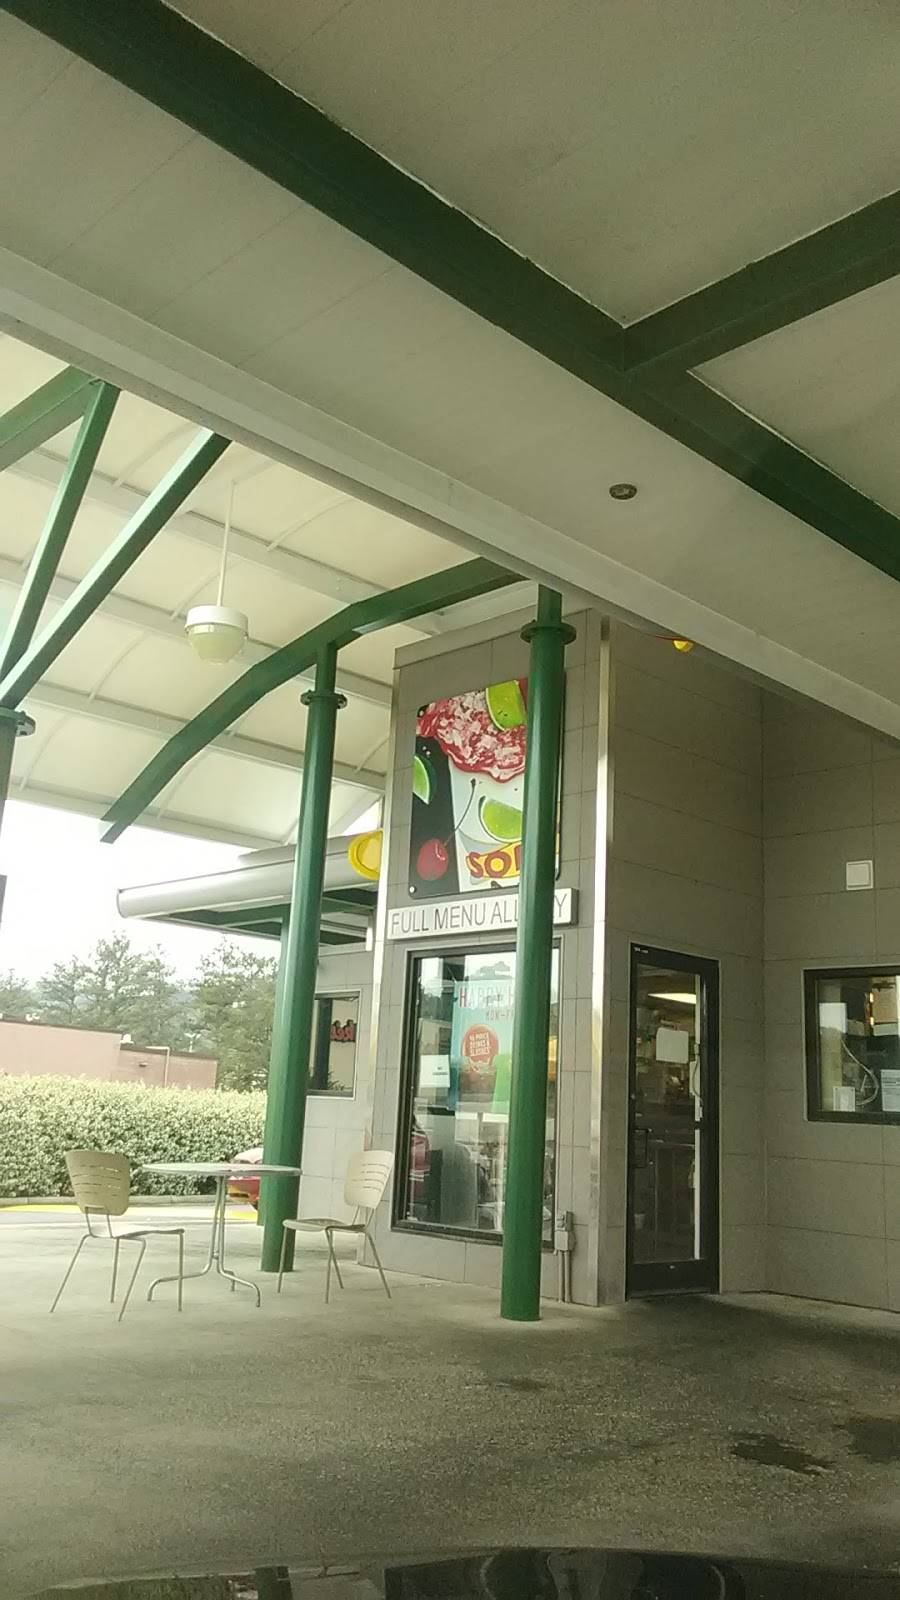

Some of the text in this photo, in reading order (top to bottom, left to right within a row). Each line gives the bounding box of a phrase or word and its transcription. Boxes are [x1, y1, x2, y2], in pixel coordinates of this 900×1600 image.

[391, 899, 519, 934] FULL MENU ALL
[459, 986, 506, 1008] HAPPY
